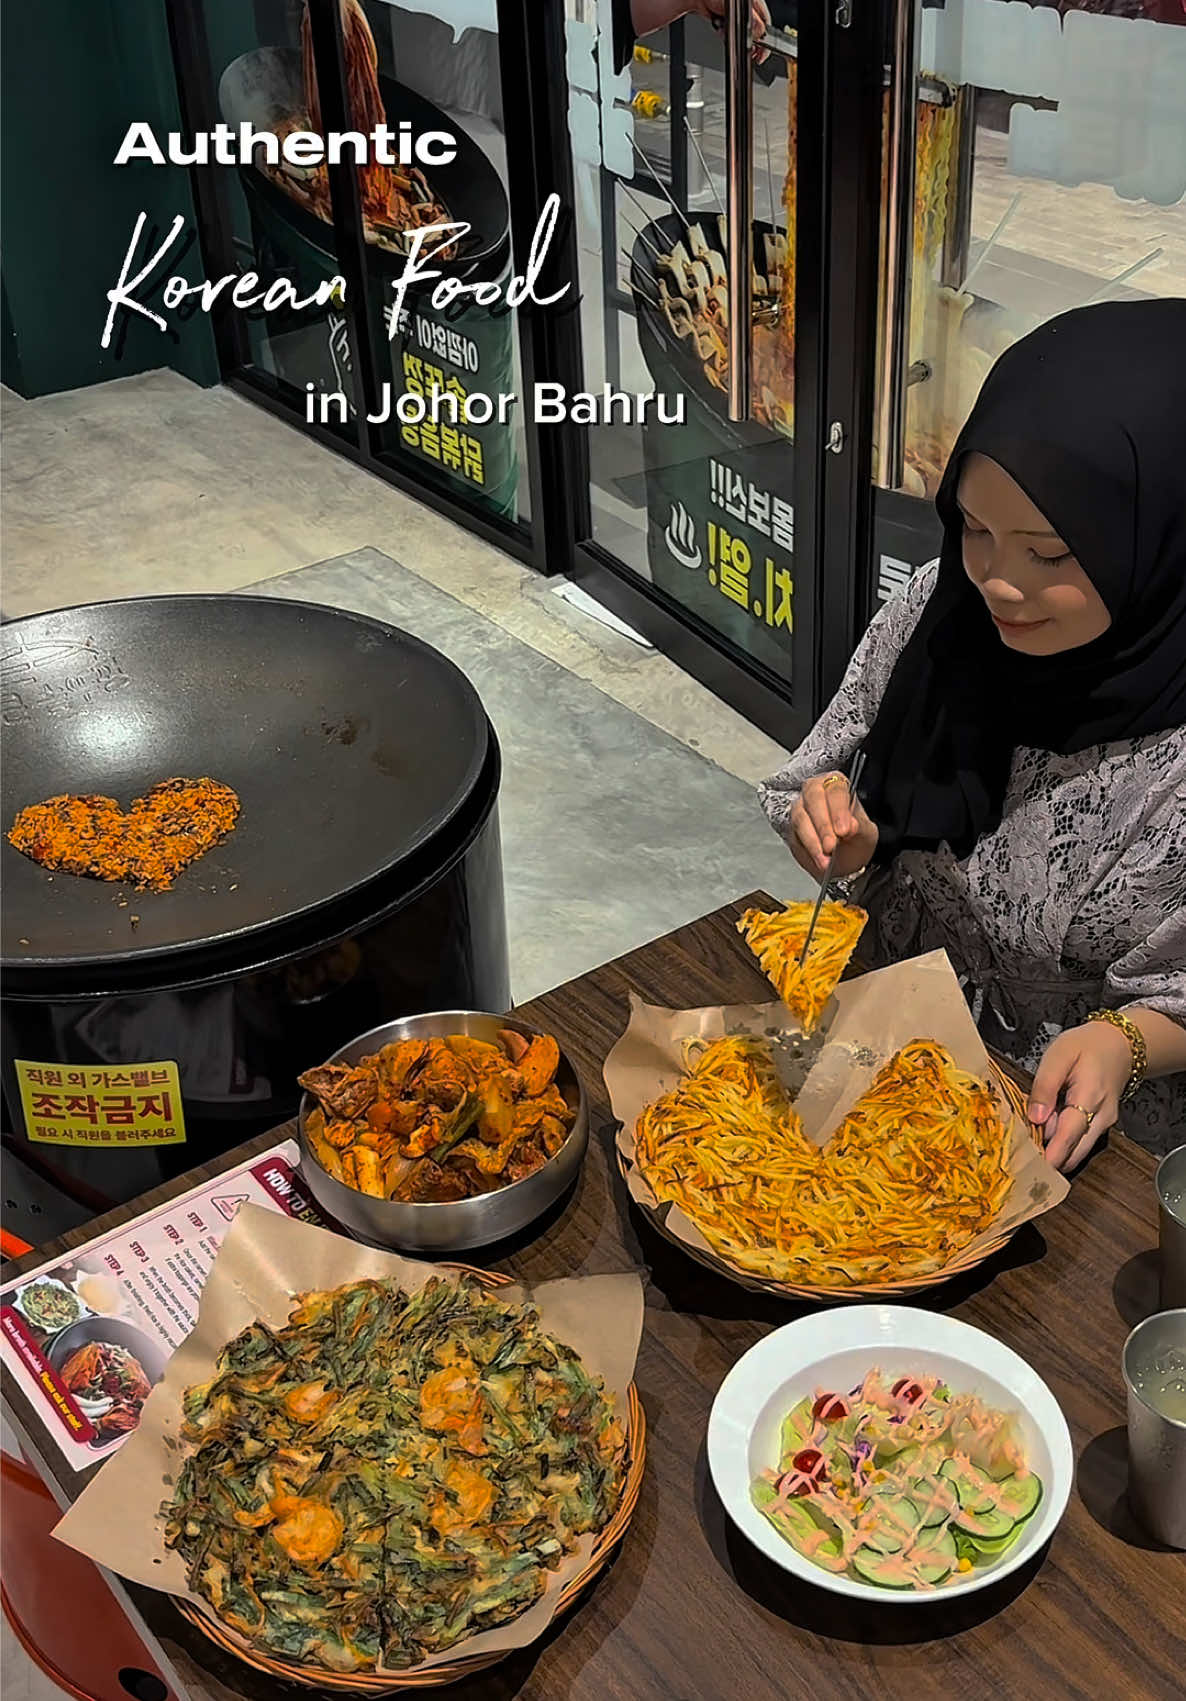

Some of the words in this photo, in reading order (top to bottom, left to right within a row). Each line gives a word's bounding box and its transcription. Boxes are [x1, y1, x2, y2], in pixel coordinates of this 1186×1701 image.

[26, 1069, 63, 1087] 직원
[67, 1072, 86, 1088] 외
[92, 1069, 170, 1088] 가스밸브
[32, 1092, 173, 1124] 조작금지
[62, 1127, 73, 1138] 시
[77, 1129, 112, 1141] 직원을
[115, 1127, 177, 1141] 불러주세요
[263, 1167, 294, 1197] HOW
[285, 1192, 307, 1212] TO
[187, 1211, 204, 1229] STEP
[163, 1224, 180, 1241] STEP
[129, 1240, 147, 1259] STEP
[104, 1254, 121, 1271] STEP
